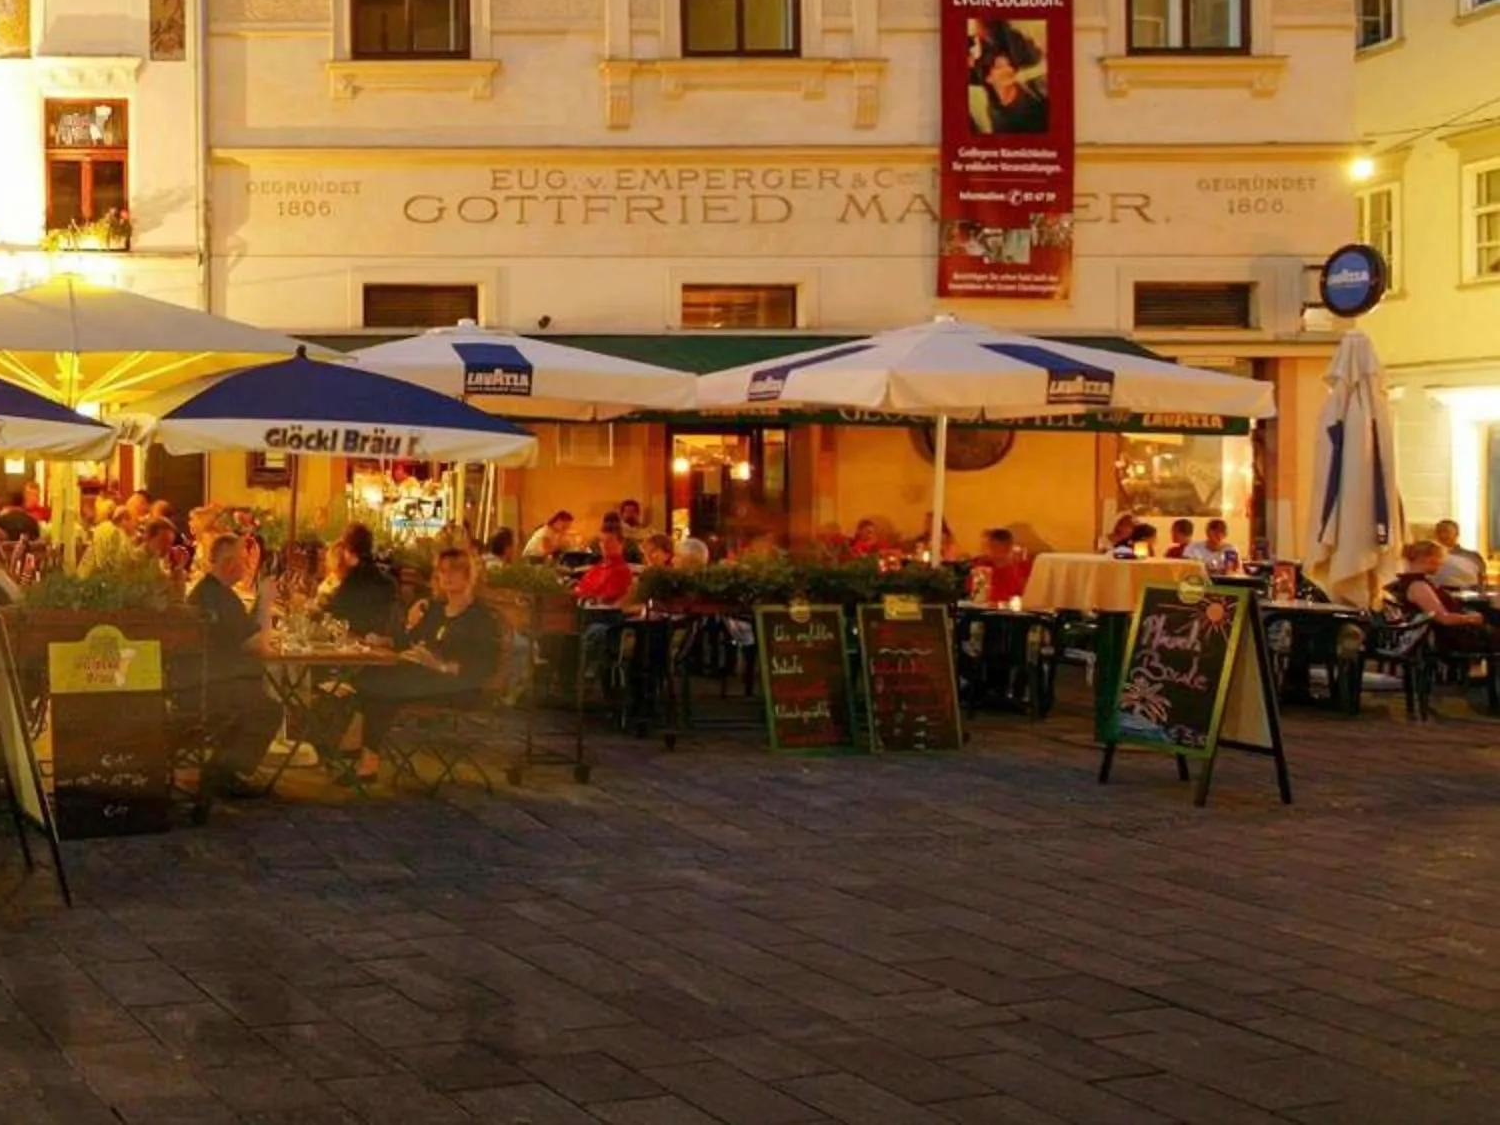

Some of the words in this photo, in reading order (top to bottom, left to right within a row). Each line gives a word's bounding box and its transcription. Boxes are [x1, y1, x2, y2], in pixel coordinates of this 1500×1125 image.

[614, 169, 843, 191] EMPERGER
[402, 194, 793, 225] GOTTFRIED
[467, 368, 529, 386] LAVAZZA
[264, 424, 339, 452] Glöckl
[342, 428, 402, 455] Bräu
